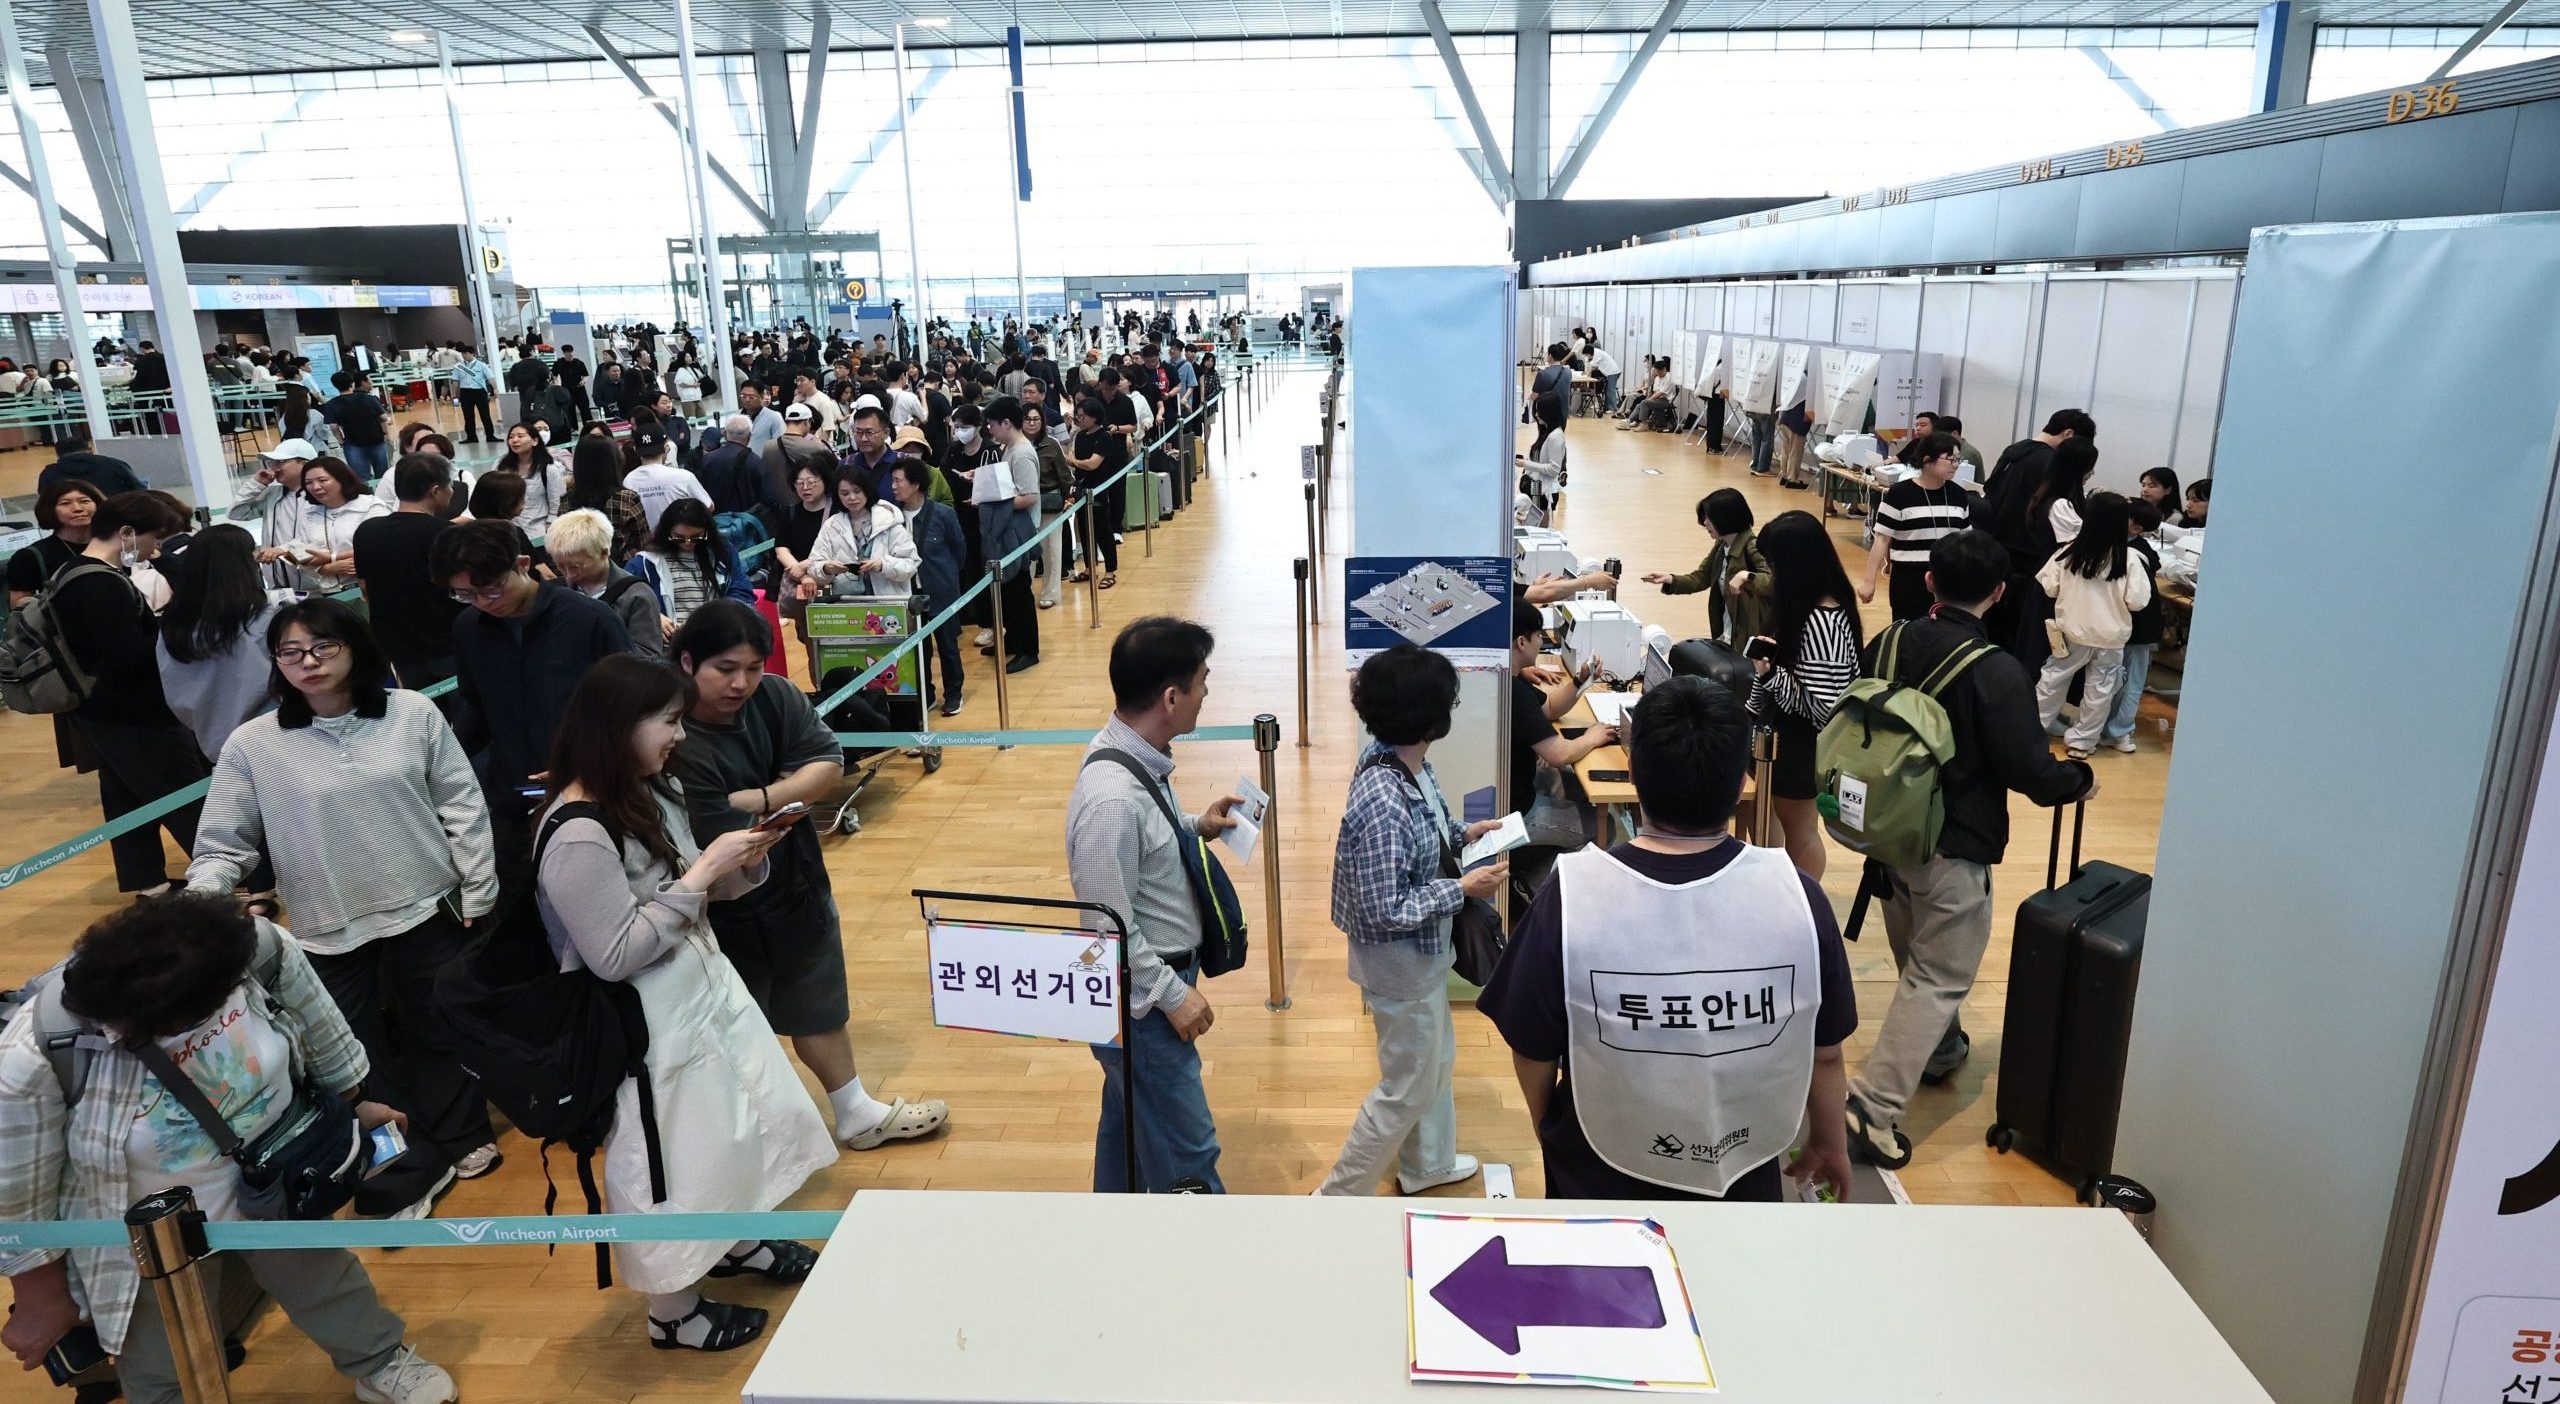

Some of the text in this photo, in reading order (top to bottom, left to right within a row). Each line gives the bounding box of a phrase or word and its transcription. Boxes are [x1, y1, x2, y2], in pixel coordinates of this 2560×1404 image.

[2386, 80, 2459, 124] D36
[2020, 159, 2051, 182] D34
[2106, 144, 2144, 170] D35
[969, 737, 996, 745] Airport
[23, 834, 104, 875] Incheon Airport
[938, 961, 1113, 1007] 관외선거인
[1617, 986, 1776, 1031] 투표안내
[495, 1227, 618, 1240] Incheon Airport
[2512, 1330, 2560, 1363] 공
